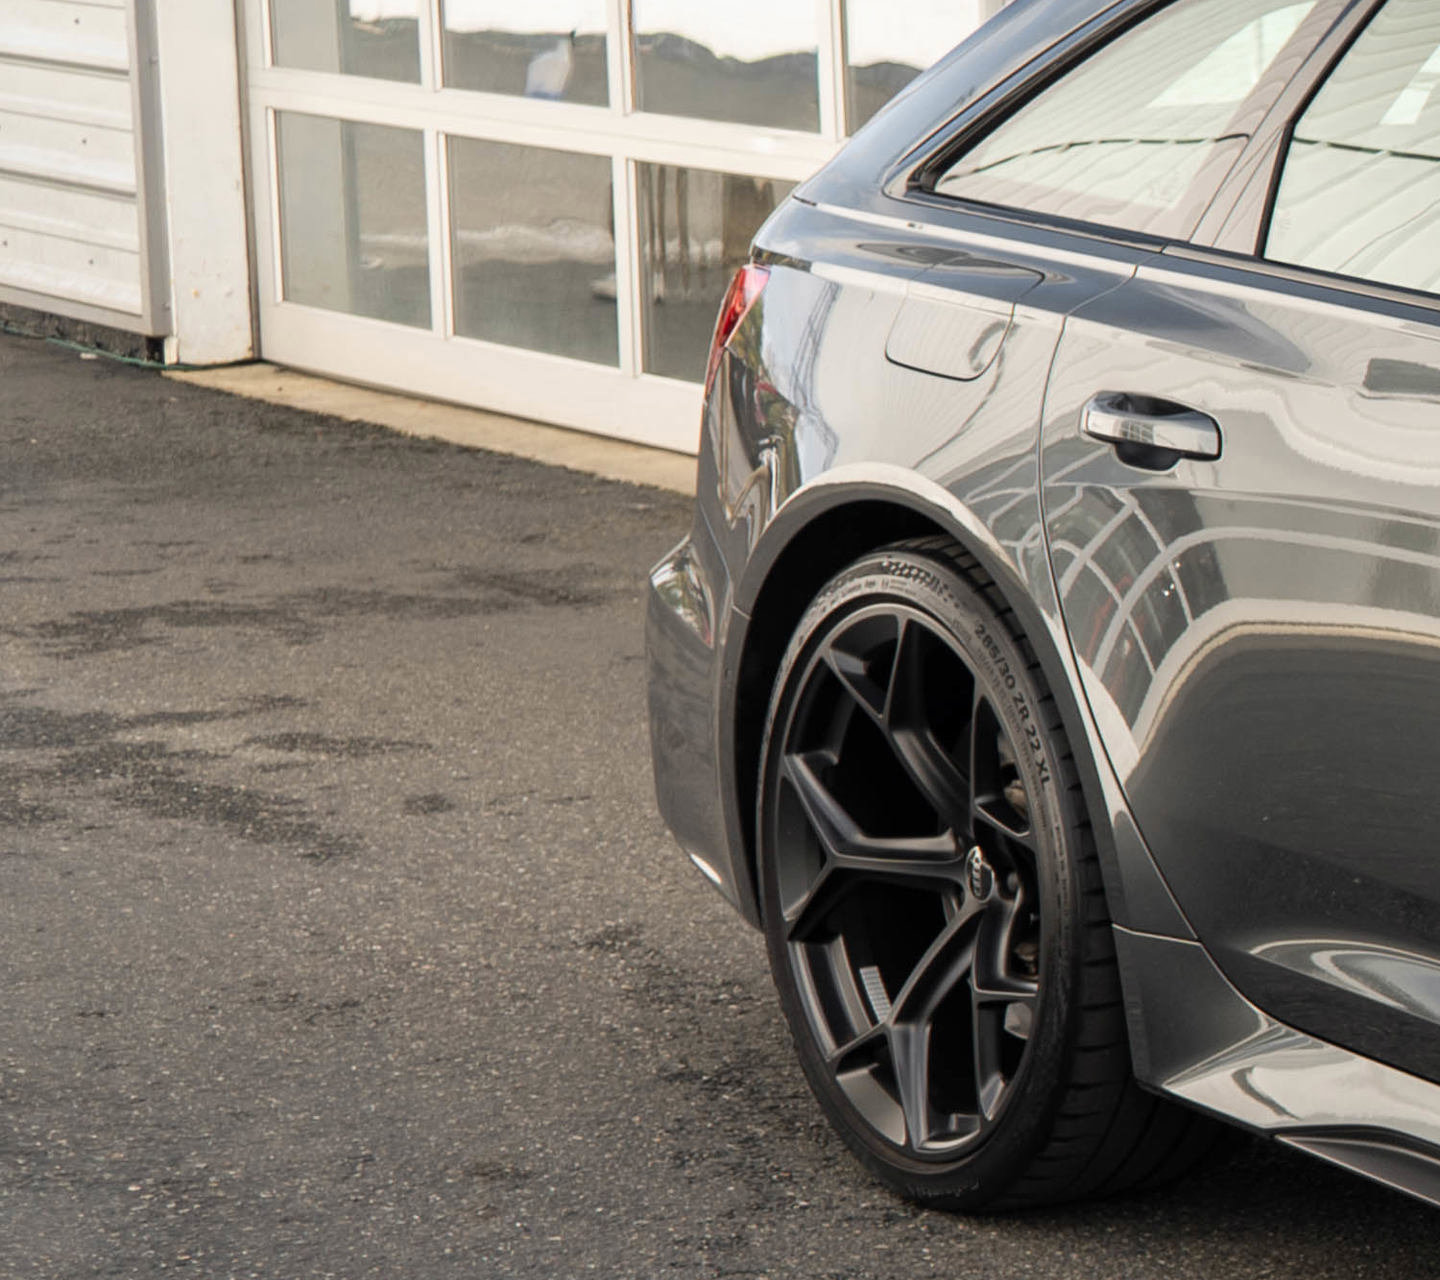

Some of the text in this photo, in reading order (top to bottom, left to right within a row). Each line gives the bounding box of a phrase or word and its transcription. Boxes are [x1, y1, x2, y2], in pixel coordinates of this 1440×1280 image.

[974, 623, 1017, 691] 285/30
[1012, 691, 1030, 722] ZR
[1024, 724, 1042, 754] 22
[1035, 757, 1051, 793] XL
